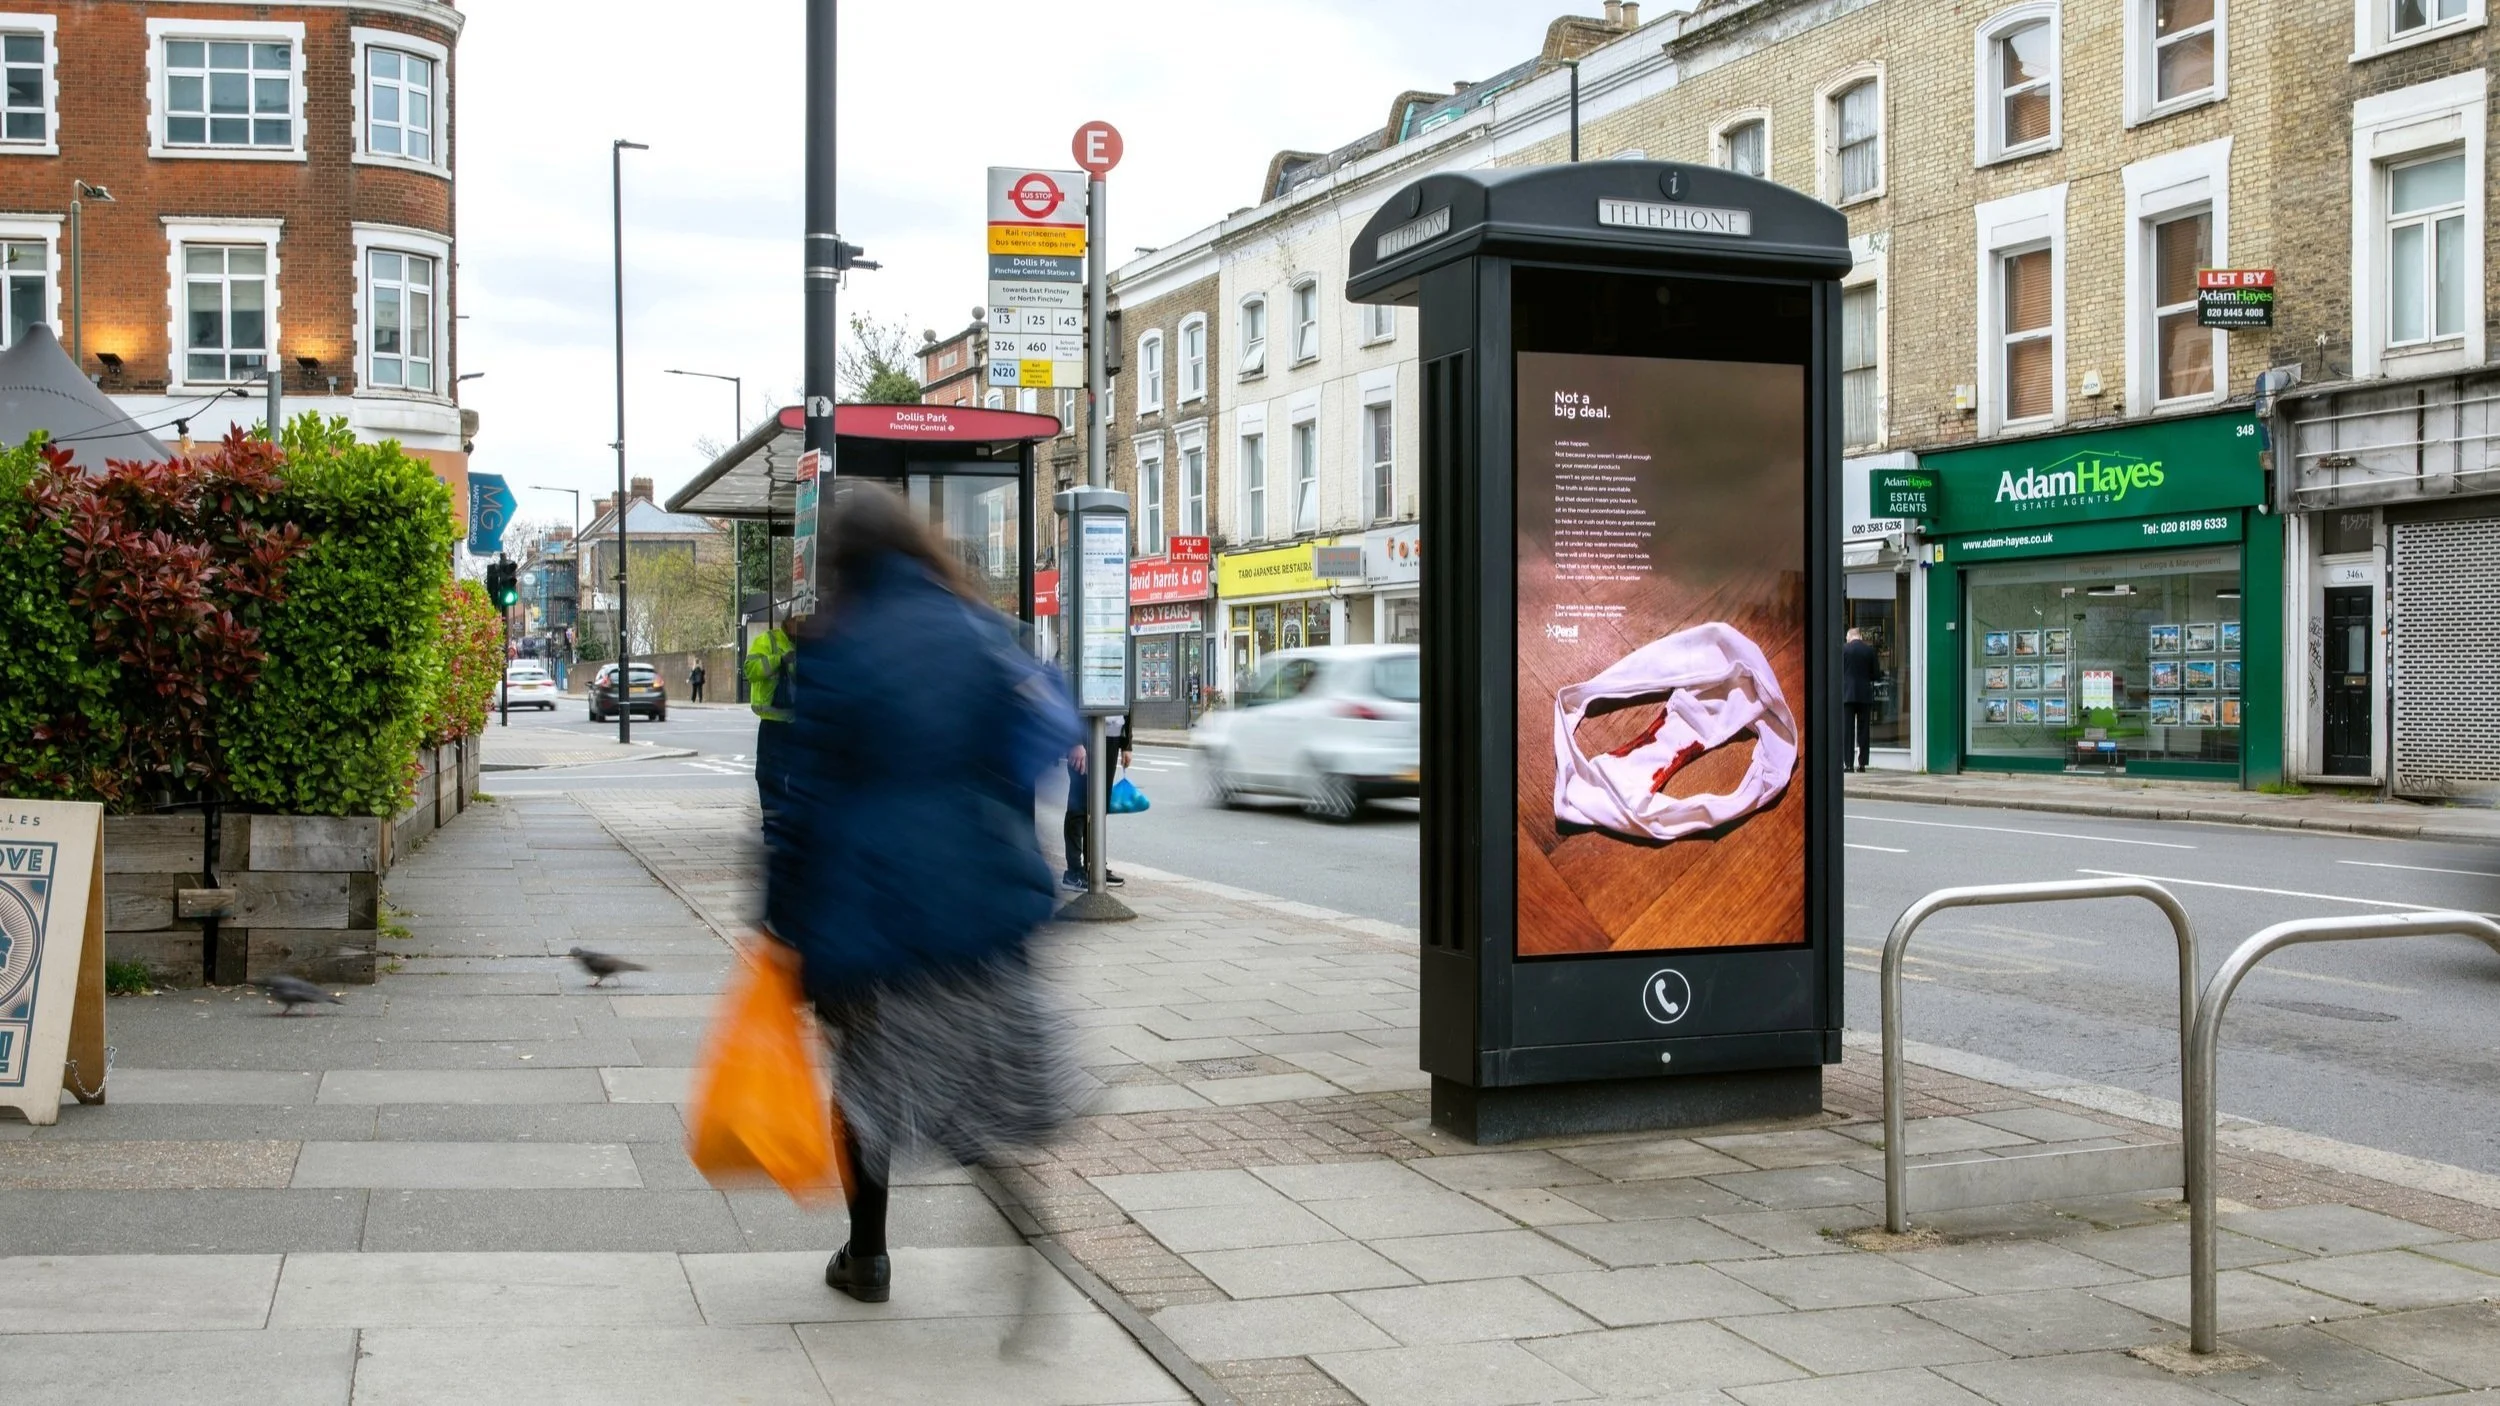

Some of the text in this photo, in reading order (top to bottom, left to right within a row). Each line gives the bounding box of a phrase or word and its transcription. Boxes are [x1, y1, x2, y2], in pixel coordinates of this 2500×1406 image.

[1087, 130, 1108, 163] E
[1605, 203, 1739, 233] TELEPHONE
[1022, 230, 1066, 238] replacement
[1385, 212, 1447, 254] TELEPHONE
[1014, 258, 1058, 267] Dollis Park
[2207, 272, 2266, 285] LET BY
[1044, 288, 1070, 296] Finchley
[2199, 290, 2272, 304] AdamHayes
[1038, 296, 1063, 304] Finchley
[999, 314, 1010, 324] 13
[2207, 308, 2264, 317] 020 8445 4008
[1028, 315, 1045, 325] 125
[1059, 316, 1076, 326] 143
[995, 341, 1014, 351] 326
[1027, 342, 1047, 352] 460
[993, 367, 1015, 377] N20
[1555, 391, 1590, 404] Not a
[896, 412, 948, 423] Dollis Park
[1555, 404, 1611, 419] big deal.
[890, 422, 919, 432] Finchley
[2236, 424, 2254, 437] 348
[1884, 477, 1932, 489] AdamHayes
[1994, 459, 2164, 502] AdamHayes
[1890, 492, 1925, 502] ESTATE
[2015, 494, 2110, 512] ESTATE AGENTS
[481, 485, 504, 530] MG
[1889, 503, 1927, 512] AGENTS
[1852, 521, 1902, 534] 020 3583 6236
[2143, 517, 2227, 535] Tel: 020 8189 6333
[1963, 532, 2053, 550] www.adam-hayes.co.uk
[1238, 569, 1252, 579] TARO
[1254, 565, 1280, 577] JAPANESE
[1282, 562, 1312, 574] RESTAURA
[2140, 557, 2221, 571] Lettings & Management
[1153, 568, 1178, 588] harris
[1182, 566, 1188, 586] &
[1192, 569, 1202, 585] co
[1142, 604, 1190, 622] 33 YEARS
[1555, 624, 1579, 638] Persil
[0, 847, 44, 872] VE
